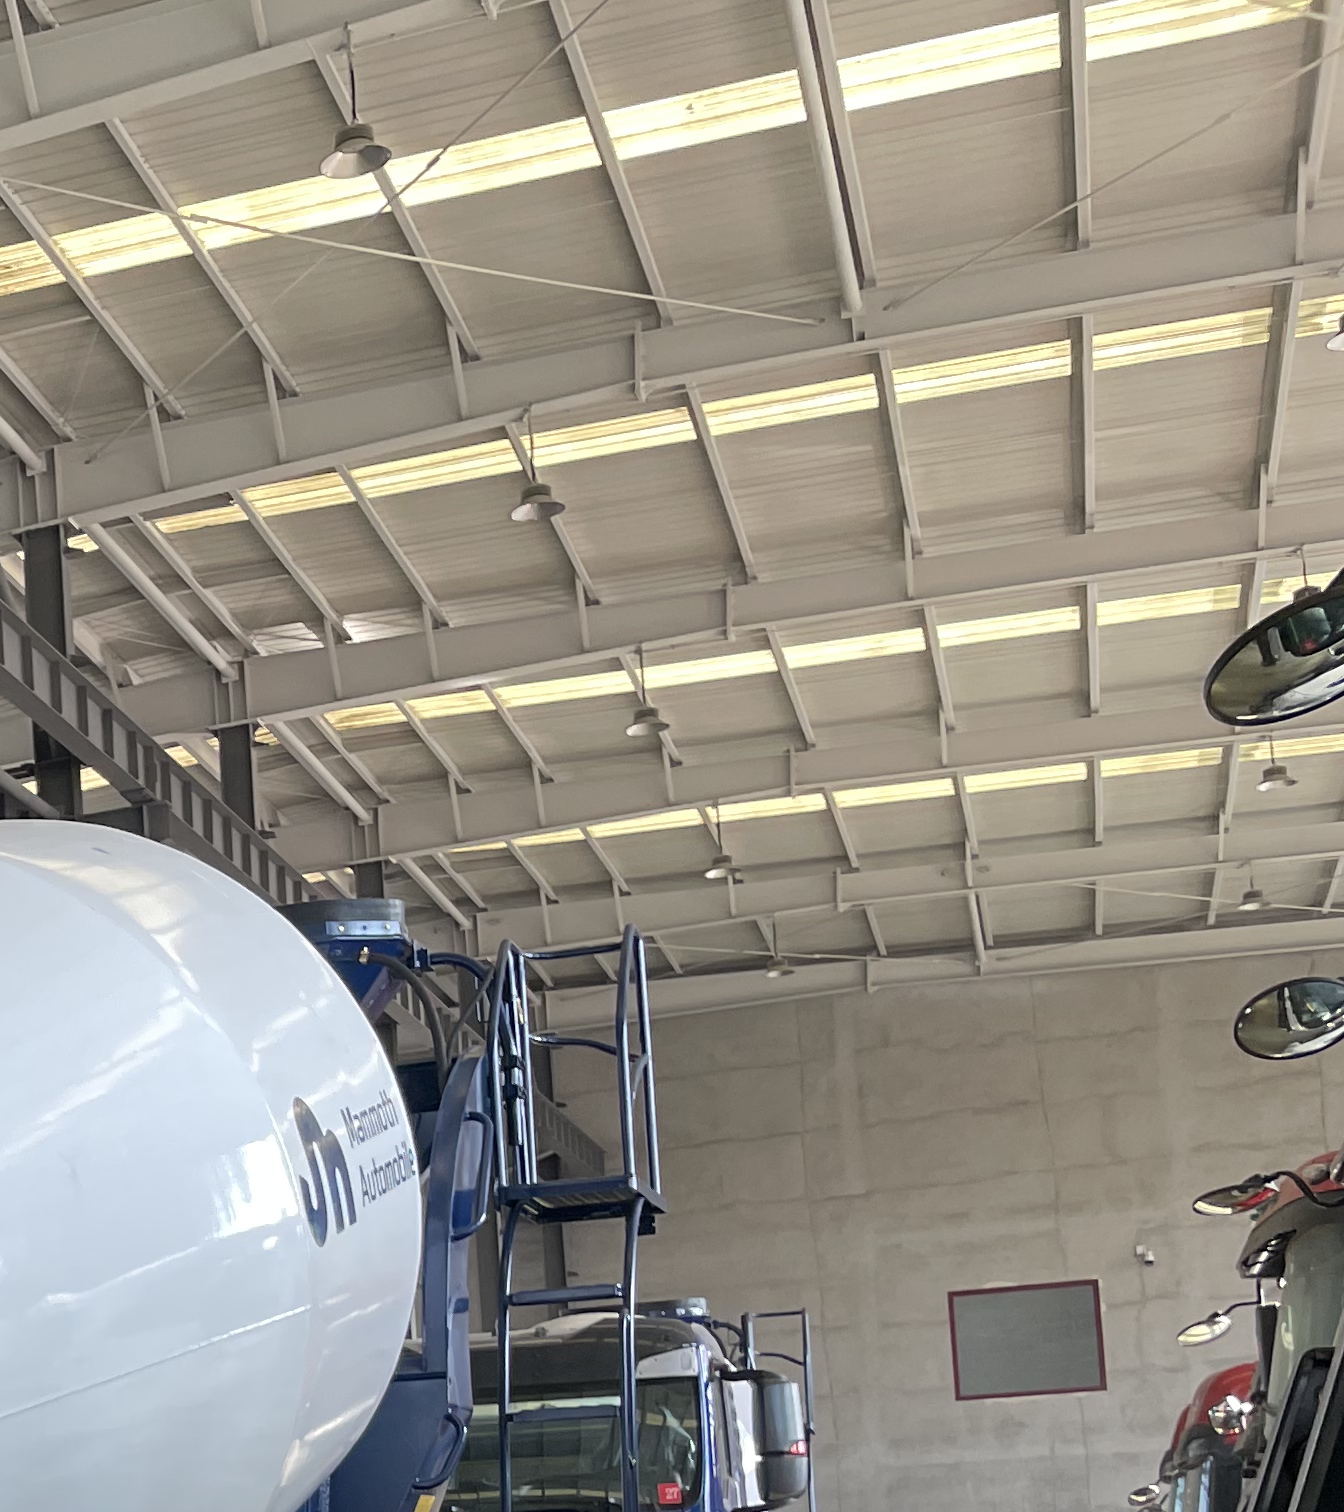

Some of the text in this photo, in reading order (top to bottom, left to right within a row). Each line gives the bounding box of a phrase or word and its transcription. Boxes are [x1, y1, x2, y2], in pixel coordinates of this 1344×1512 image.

[340, 1089, 400, 1149] Mammoth
[359, 1140, 416, 1207] Automobile
[665, 1487, 680, 1500] 27
